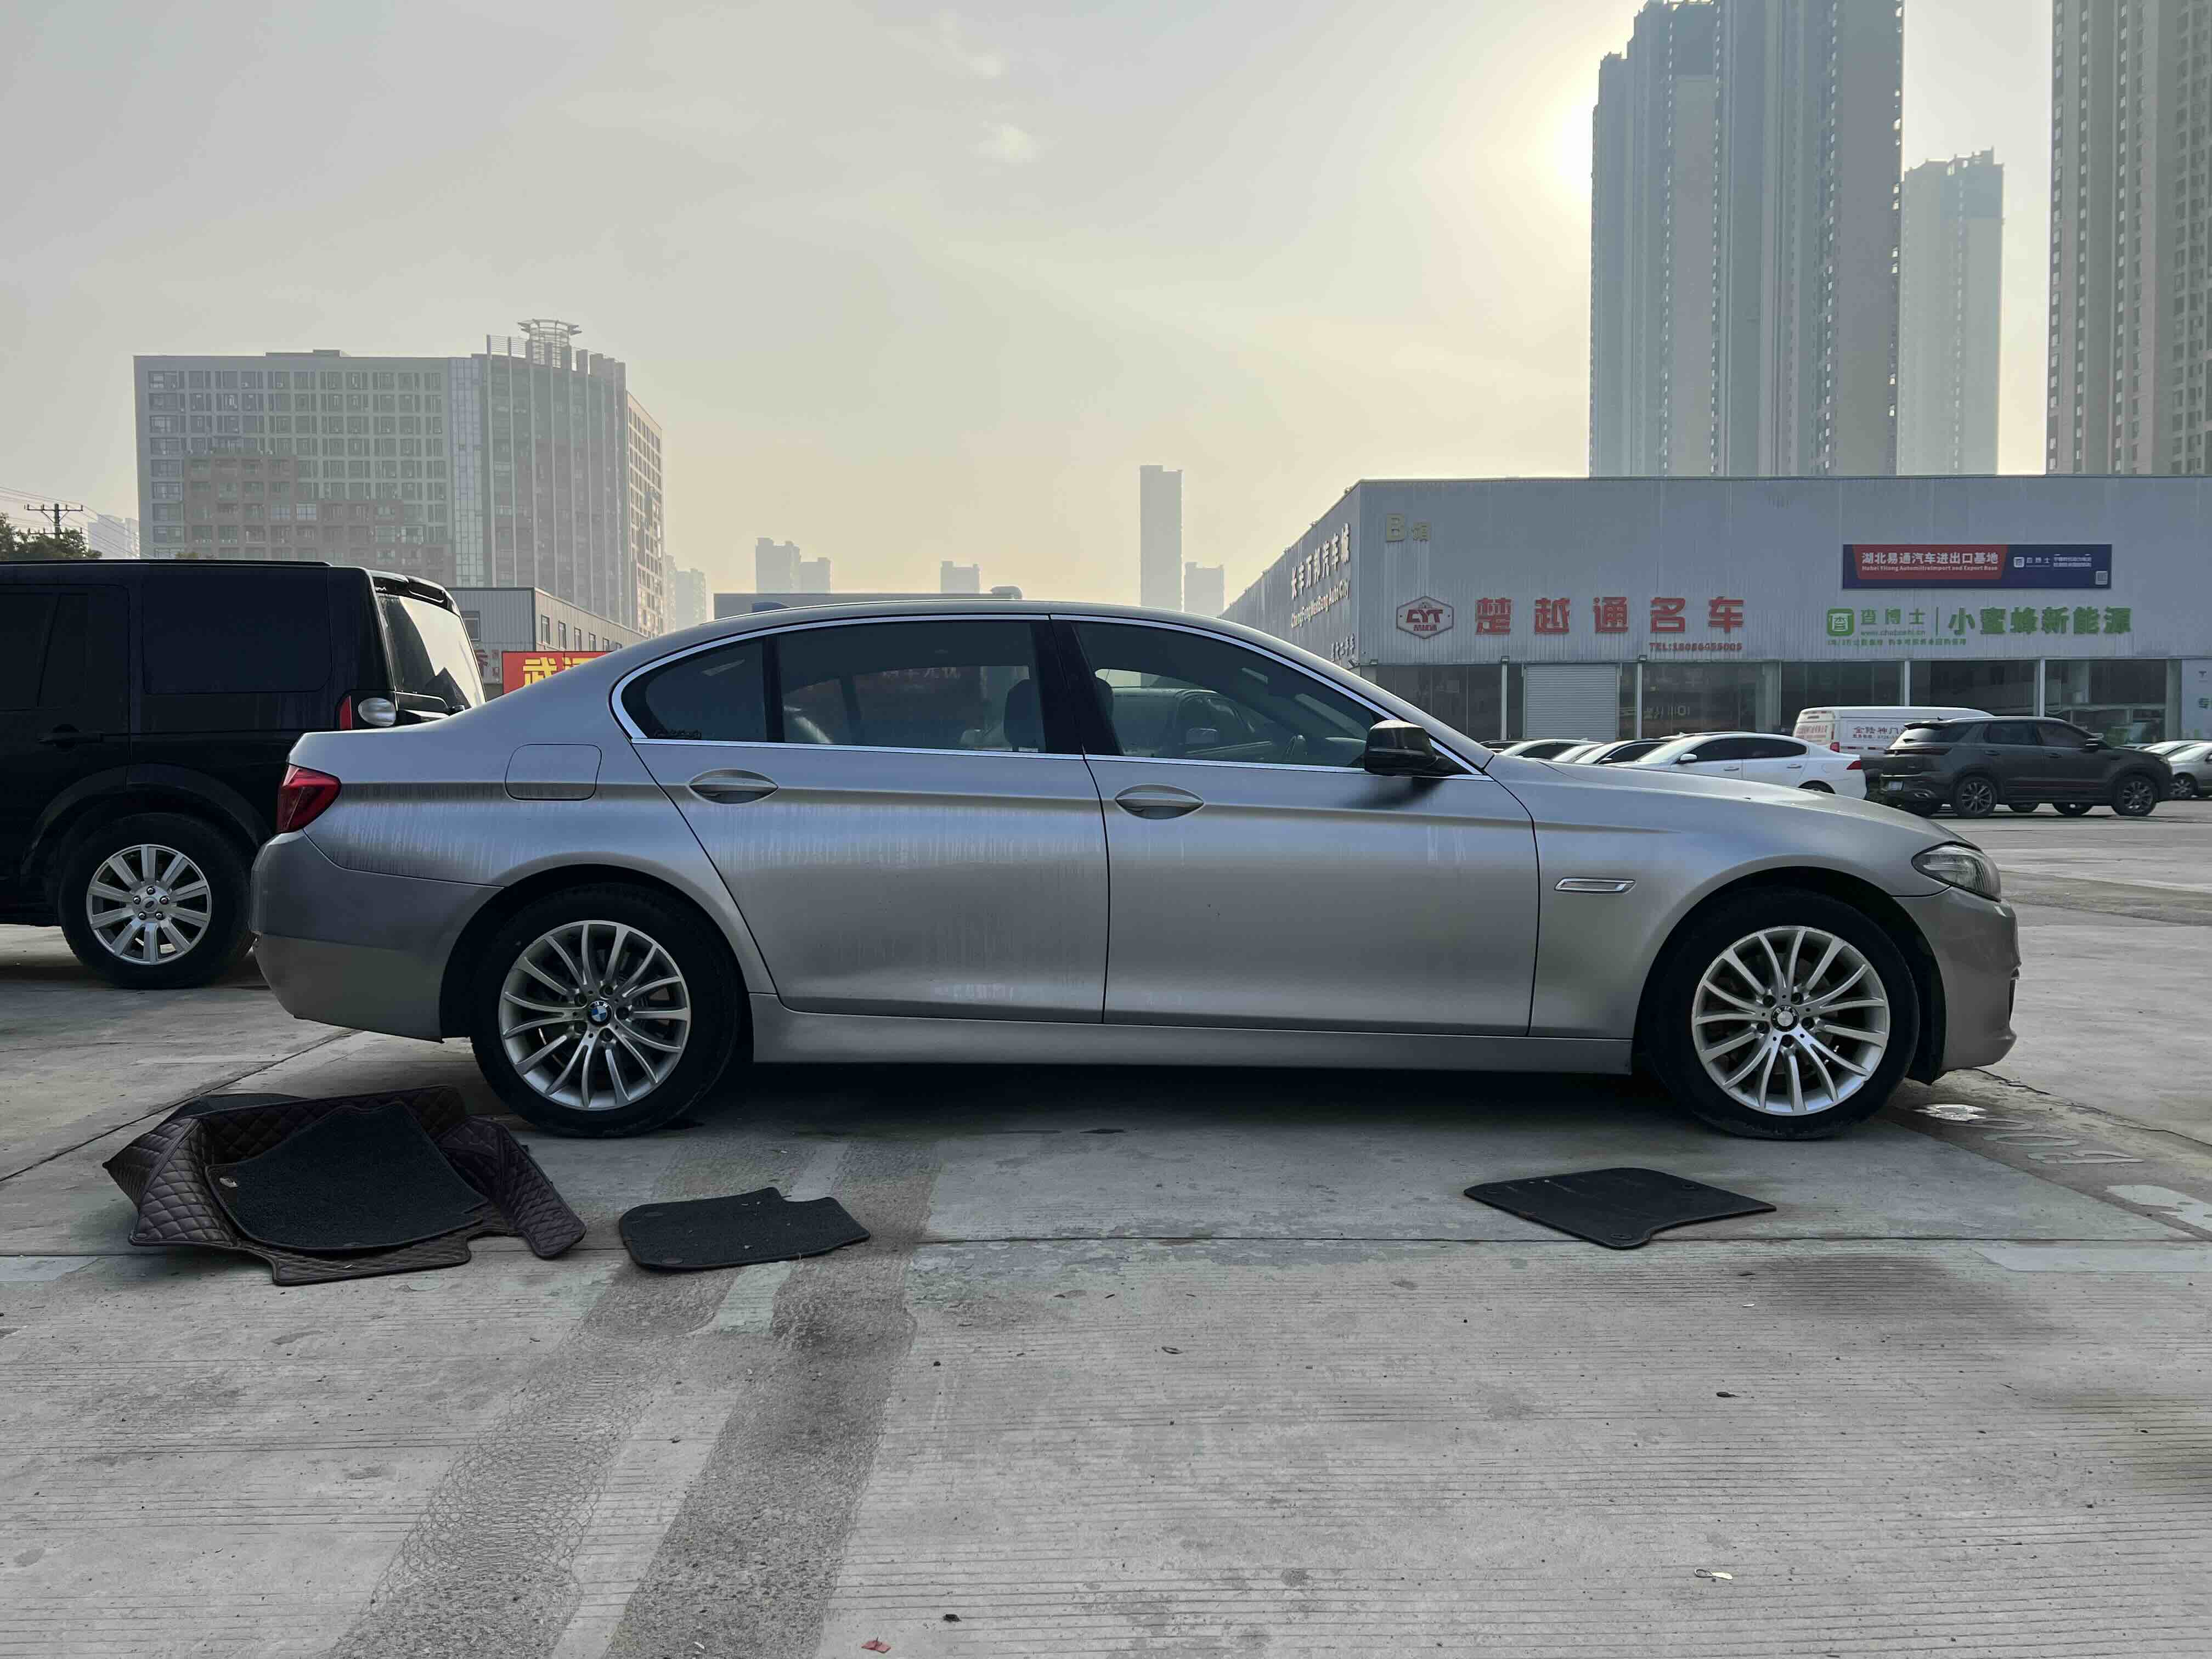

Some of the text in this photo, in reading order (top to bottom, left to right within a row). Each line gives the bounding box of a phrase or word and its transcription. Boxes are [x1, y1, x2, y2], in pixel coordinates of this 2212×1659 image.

[1862, 552, 1999, 565] 湖北易通汽车进出口基地
[1475, 596, 1744, 635] 楚越通名车
[1948, 606, 2132, 635] 小蜜蜂新能源
